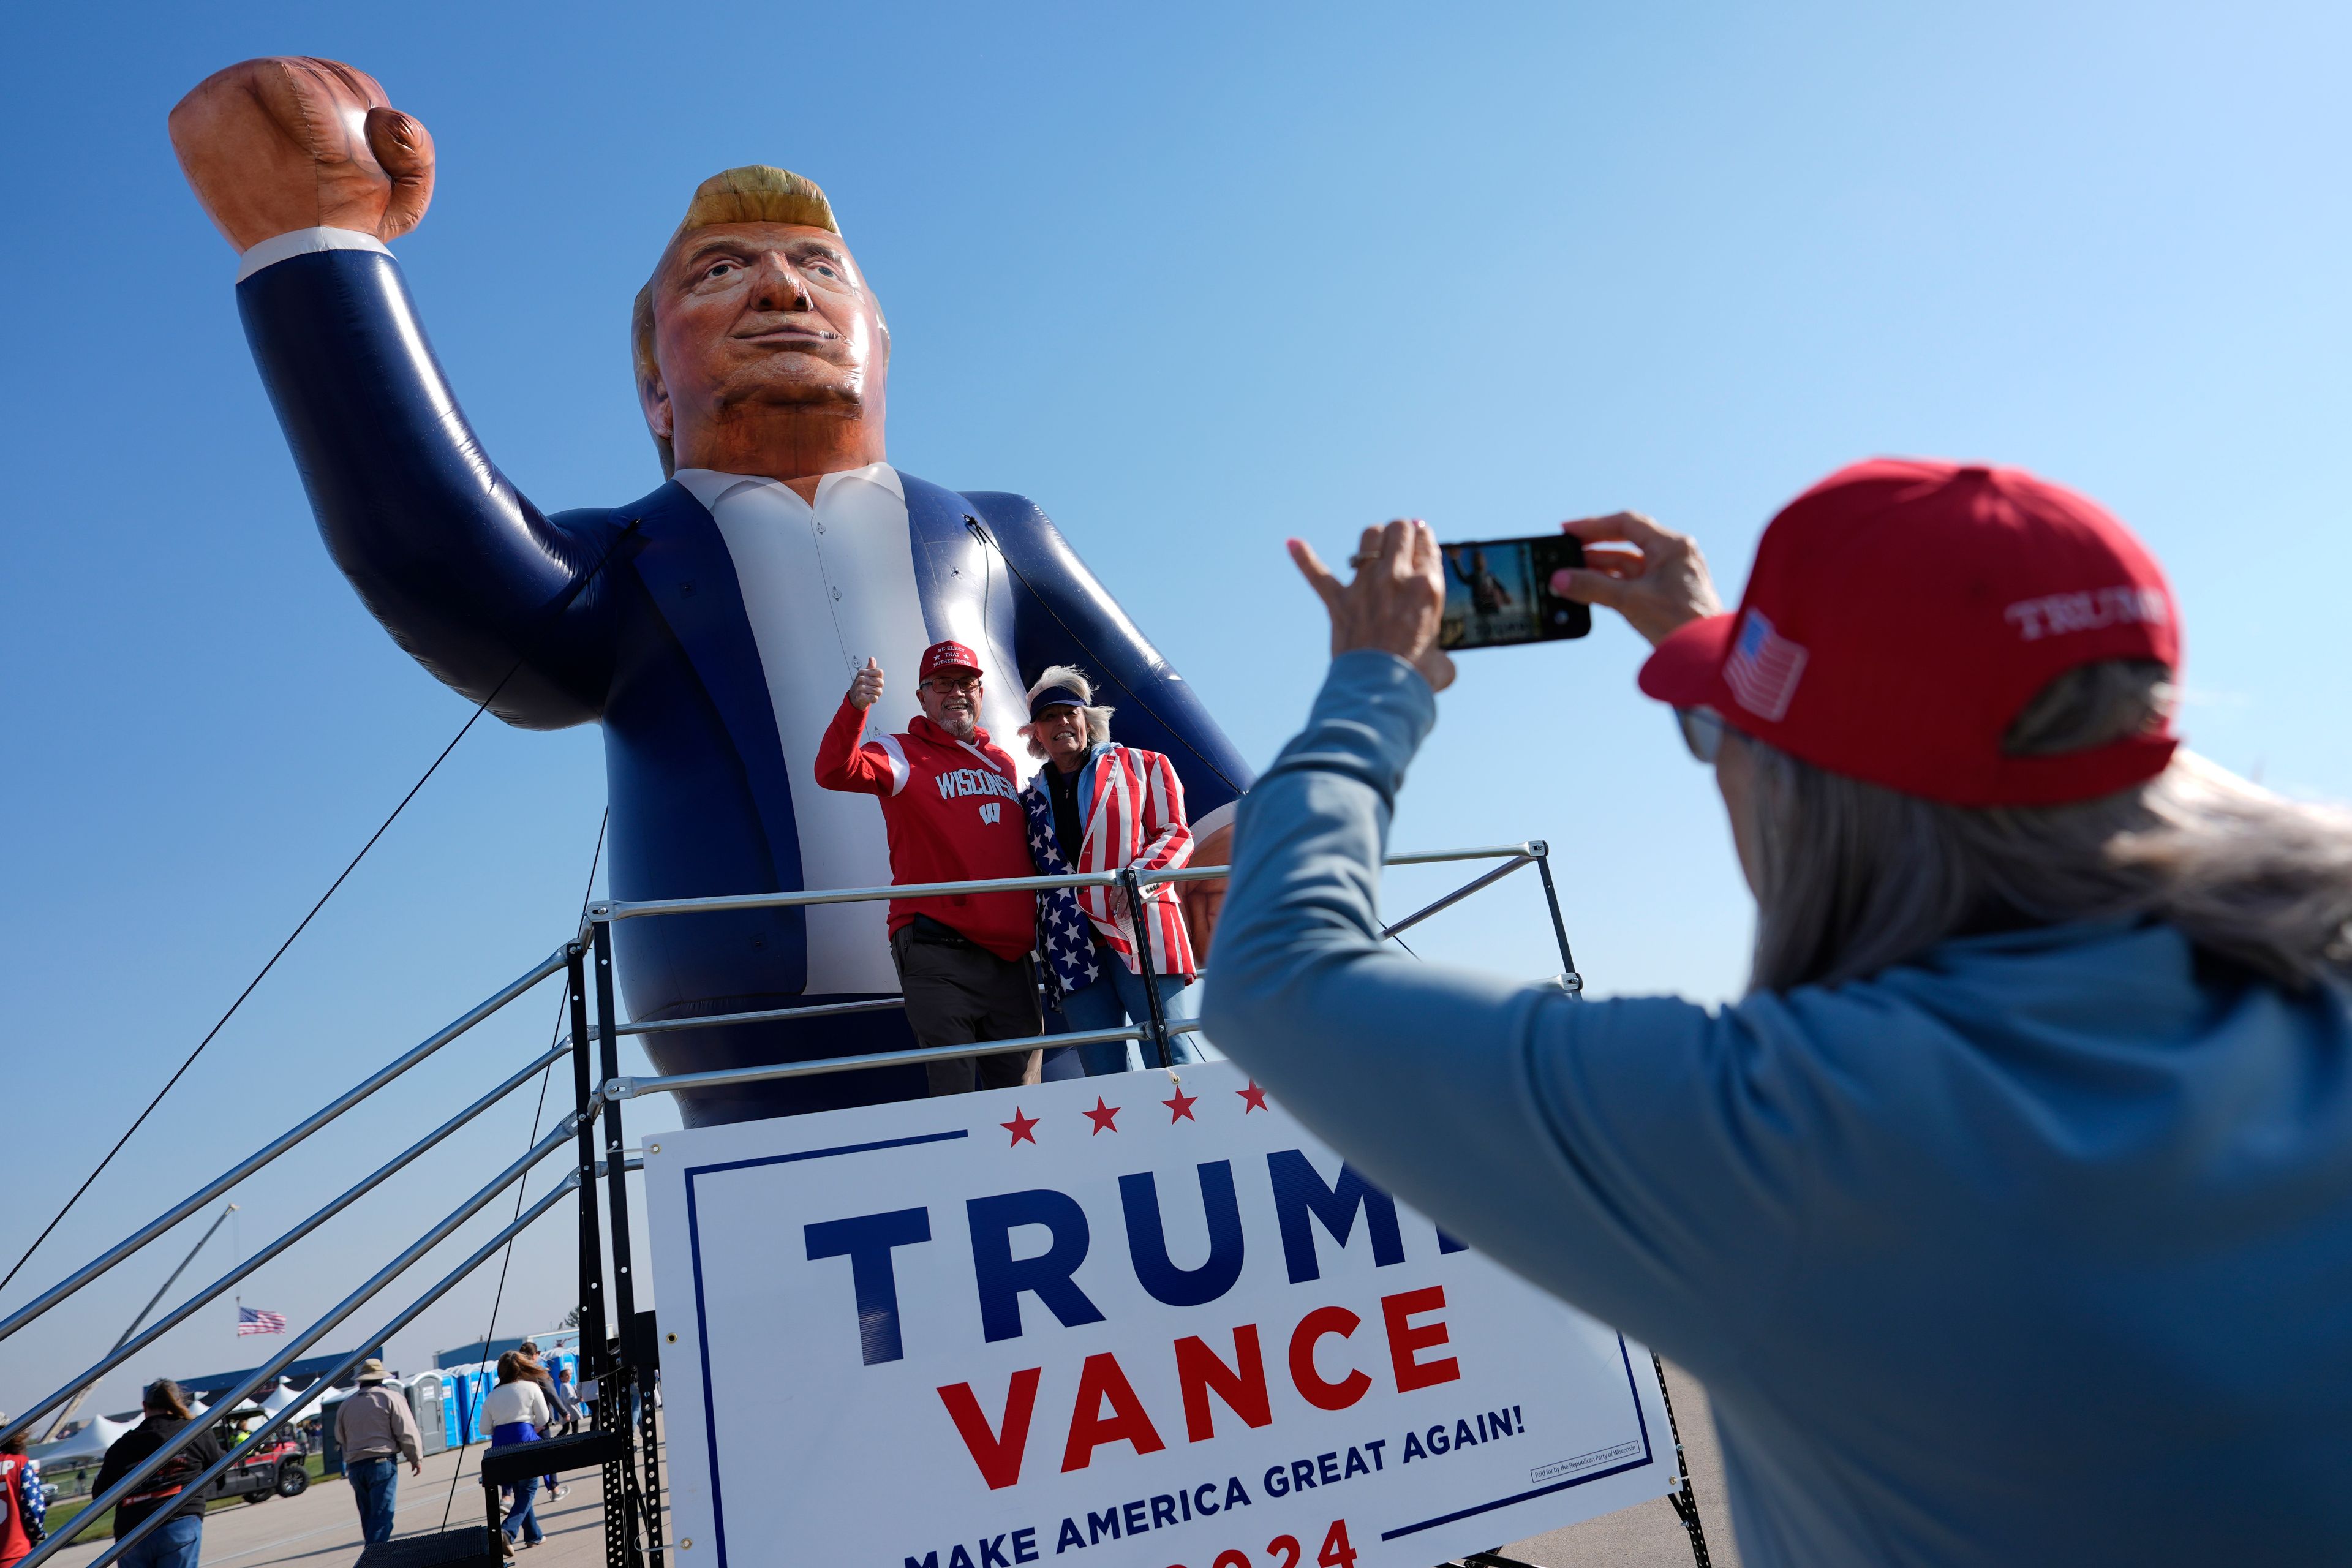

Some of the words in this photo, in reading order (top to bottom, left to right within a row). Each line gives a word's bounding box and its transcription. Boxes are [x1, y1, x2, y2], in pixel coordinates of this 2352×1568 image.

[979, 802, 1000, 826] W
[804, 1149, 1469, 1365] TRUM
[938, 1286, 1461, 1490] VANCE
[1056, 1476, 1252, 1555] AMERICA
[1264, 1439, 1386, 1498] GREAT
[1403, 1405, 1525, 1464] AGAIN!
[1569, 1457, 1596, 1468] Republican
[1613, 1445, 1636, 1456] Wisconsin
[1165, 1518, 1358, 1568] 24
